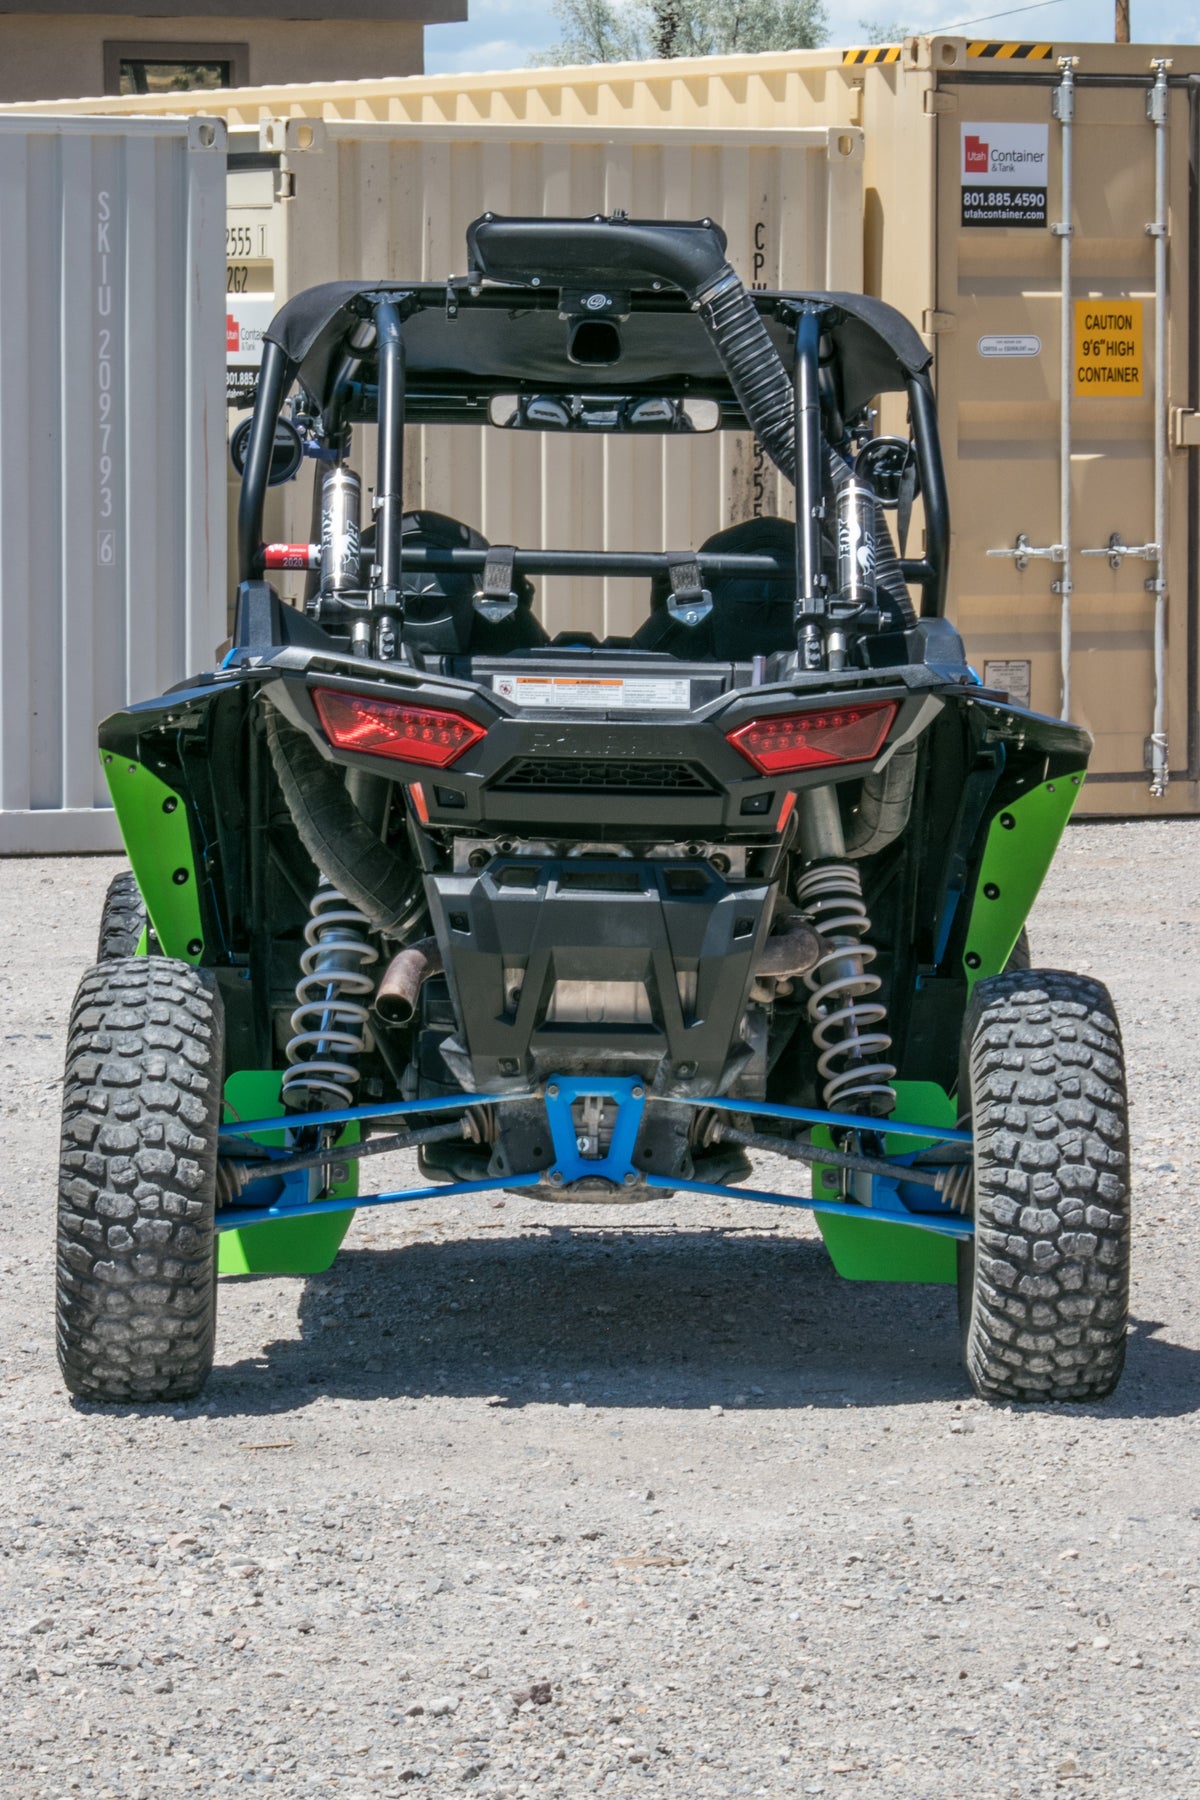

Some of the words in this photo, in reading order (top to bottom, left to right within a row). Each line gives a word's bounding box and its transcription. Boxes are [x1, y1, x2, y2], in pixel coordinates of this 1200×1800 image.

[967, 152, 986, 161] Utah
[991, 149, 1045, 162] Container
[991, 163, 997, 172] &
[998, 163, 1015, 172] Tank
[963, 192, 1045, 207] 801.885.4590
[964, 208, 1045, 219] utahcontainer.com
[98, 191, 111, 316] SKIU
[752, 222, 767, 290] CP
[1085, 314, 1133, 330] CAUTION
[1106, 341, 1135, 356] HIGH
[1078, 367, 1139, 382] CONTAINER
[99, 329, 112, 517] 209793
[100, 533, 112, 563] 6
